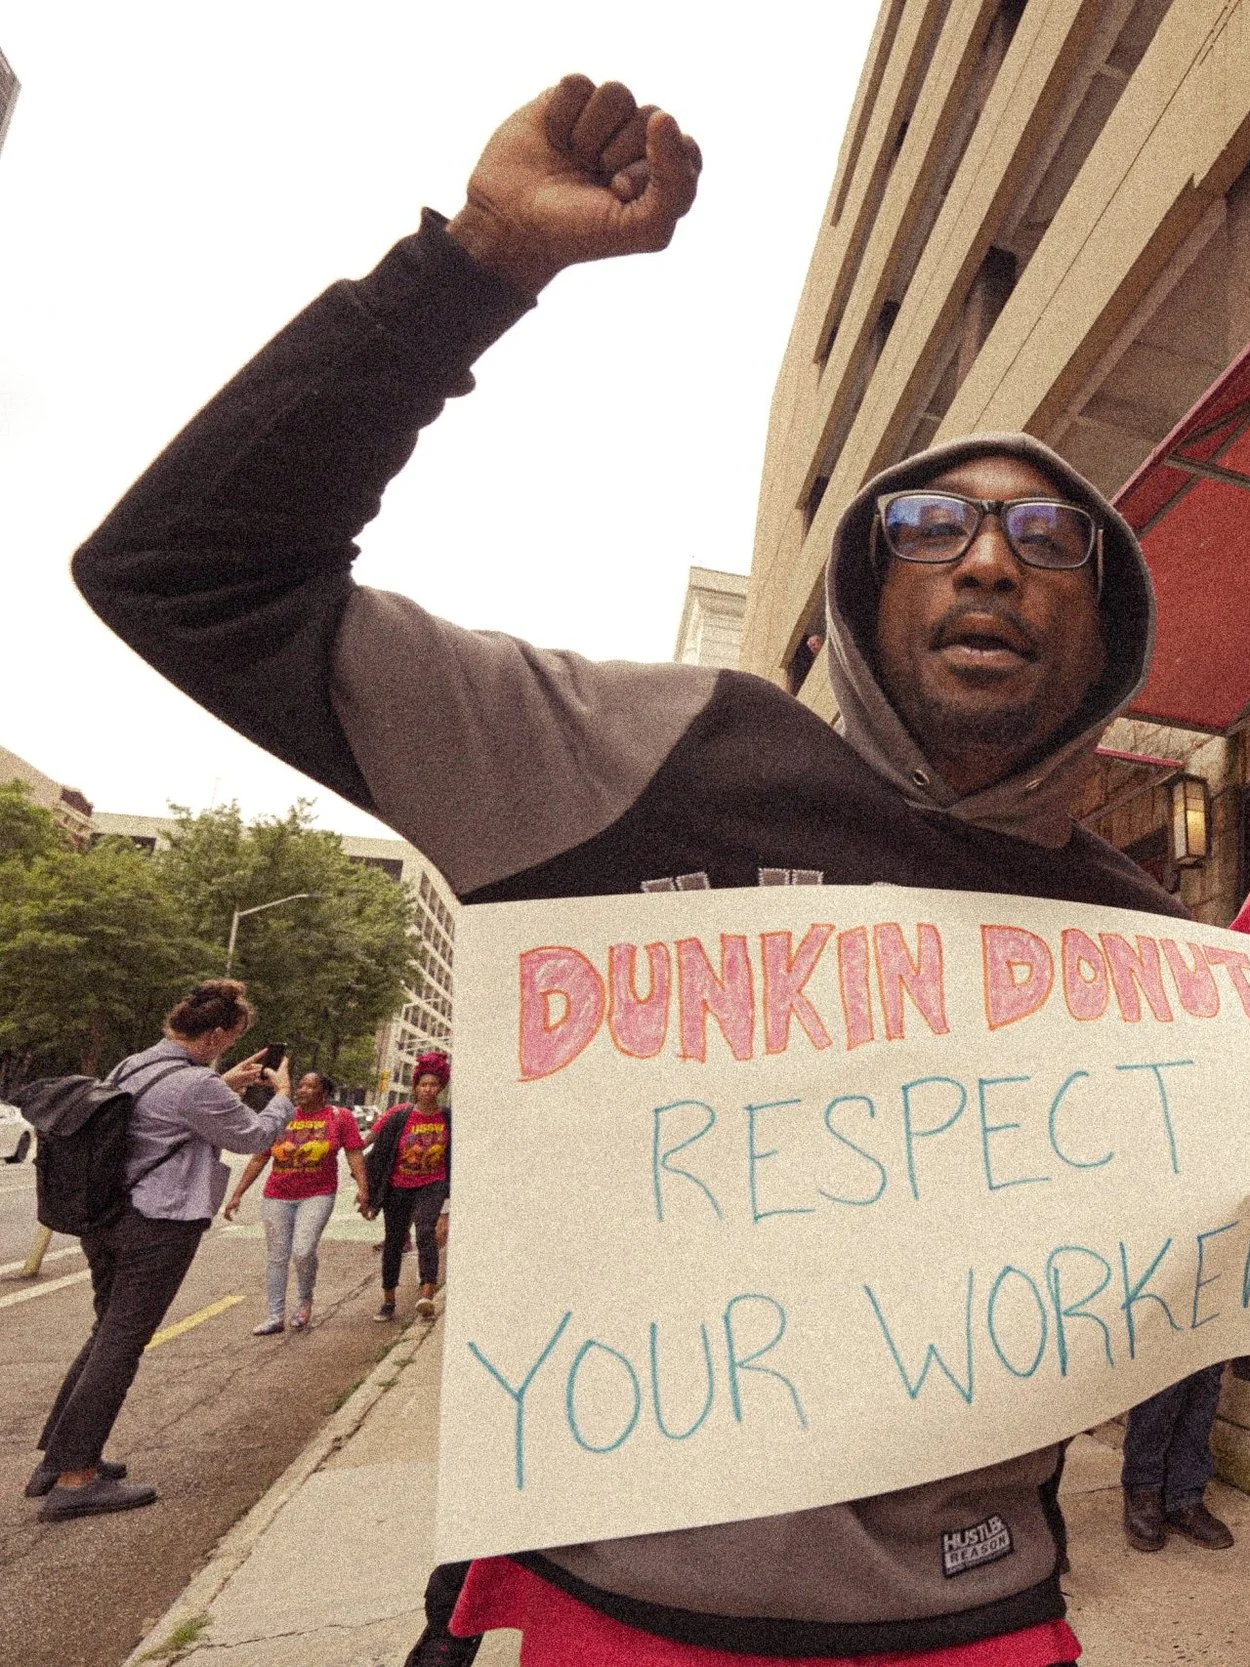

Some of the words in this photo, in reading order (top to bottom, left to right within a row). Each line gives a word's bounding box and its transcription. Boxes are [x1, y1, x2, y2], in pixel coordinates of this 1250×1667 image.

[518, 920, 951, 1083] DUNKIN
[652, 1058, 1195, 1224] RESPECT
[467, 1292, 808, 1491] YOUR
